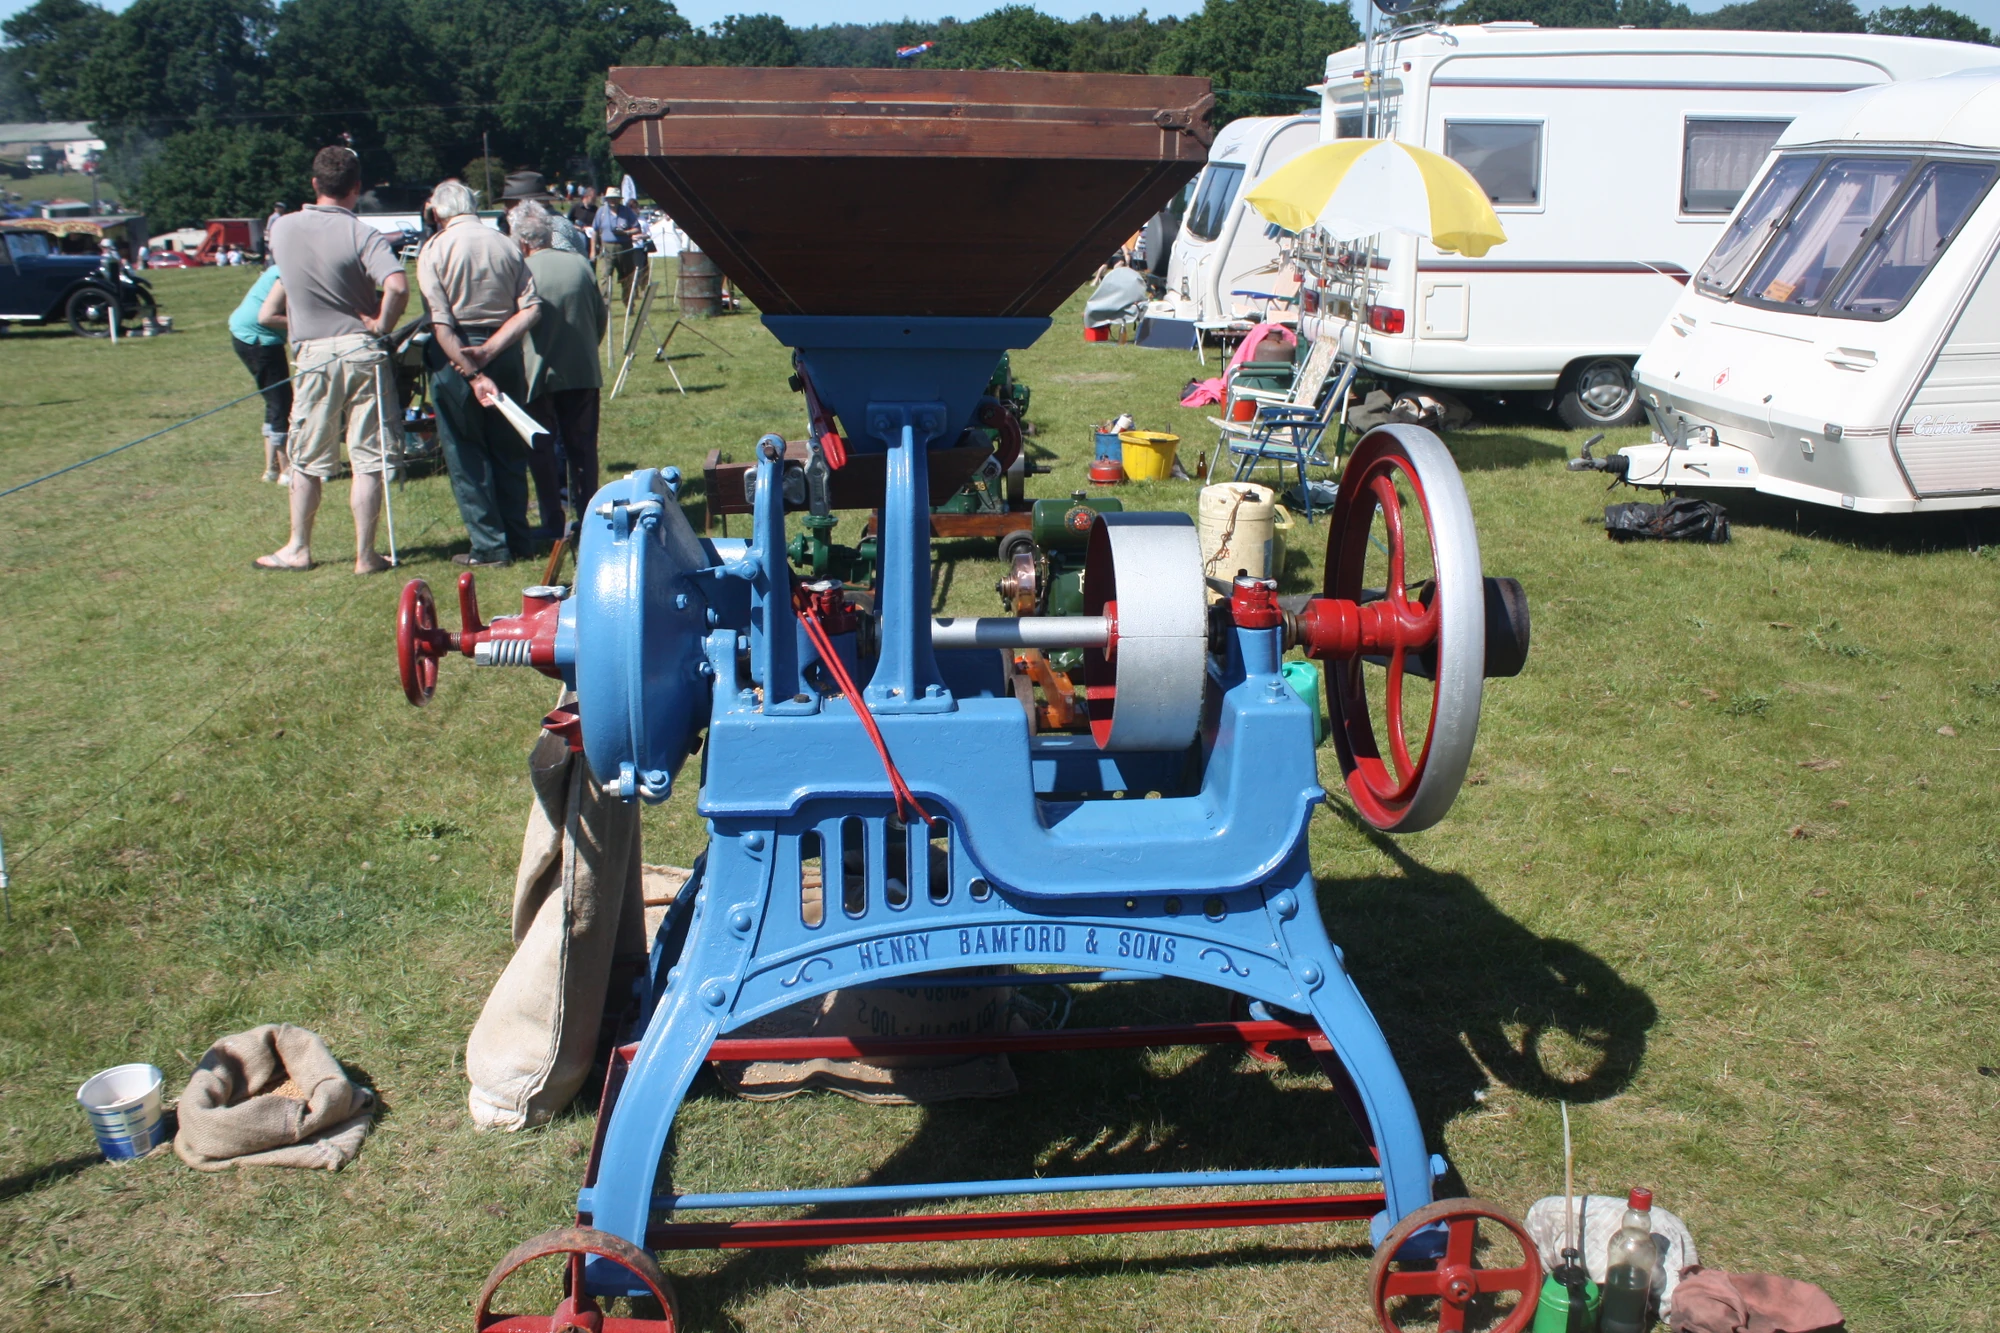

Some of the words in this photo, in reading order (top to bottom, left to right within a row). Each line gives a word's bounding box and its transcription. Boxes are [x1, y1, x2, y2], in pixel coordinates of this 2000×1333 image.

[857, 933, 930, 970] HENRY
[958, 926, 1066, 956] BAMFORD
[1085, 928, 1098, 954] &
[1118, 931, 1177, 963] SONS
